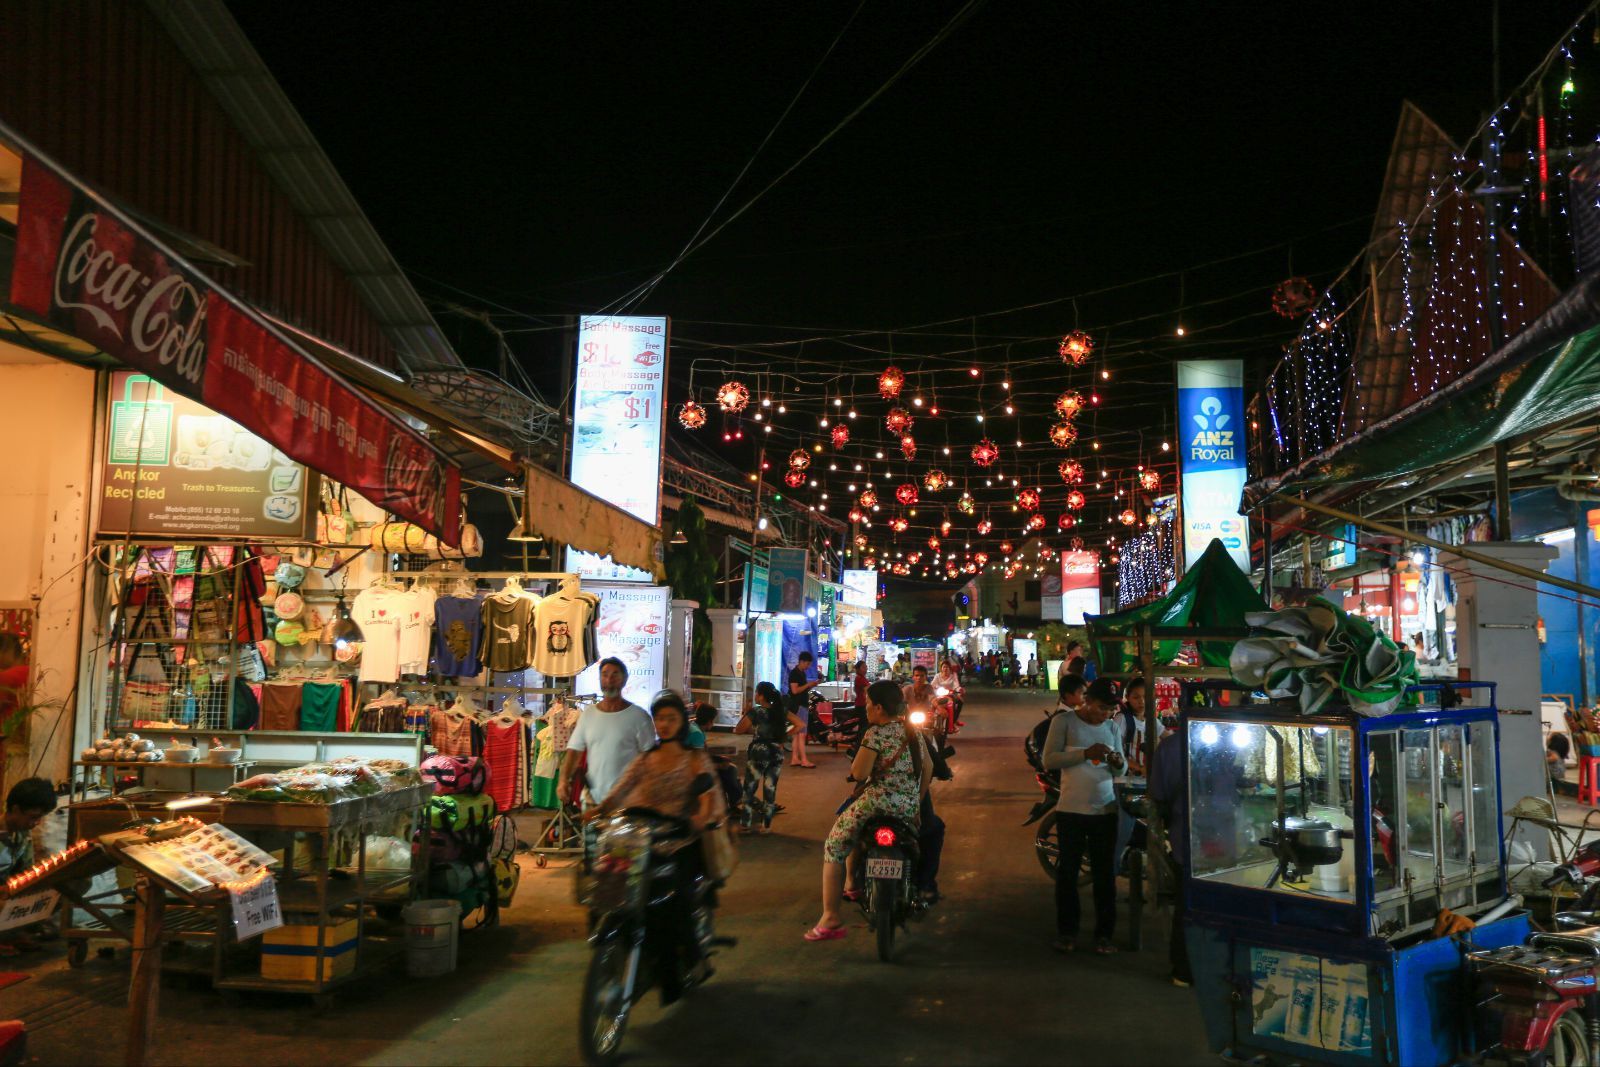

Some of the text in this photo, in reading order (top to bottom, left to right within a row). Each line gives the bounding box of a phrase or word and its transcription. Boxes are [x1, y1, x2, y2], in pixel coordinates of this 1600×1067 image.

[55, 213, 207, 384] Coca-Cola
[613, 322, 661, 334] Massage
[645, 342, 660, 350] Free
[624, 397, 650, 419] $1
[1191, 431, 1234, 446] ANZ
[1191, 447, 1234, 463] Royal
[182, 484, 205, 492] Trash
[1191, 522, 1212, 530] VISA
[609, 590, 661, 603] Massage
[609, 632, 661, 647] Massage
